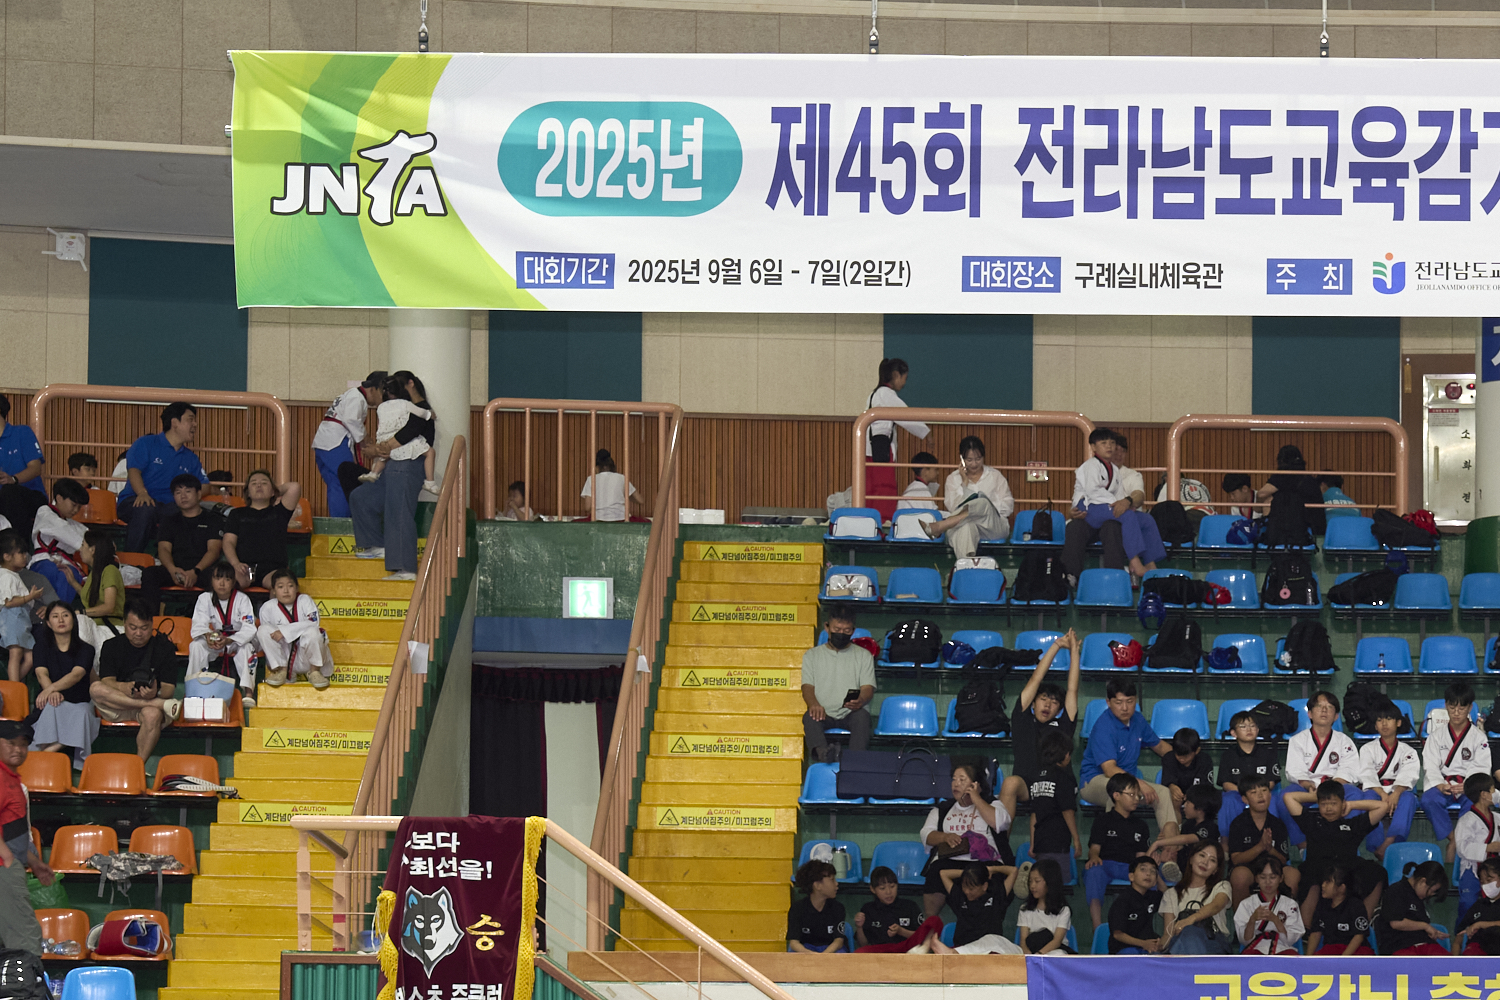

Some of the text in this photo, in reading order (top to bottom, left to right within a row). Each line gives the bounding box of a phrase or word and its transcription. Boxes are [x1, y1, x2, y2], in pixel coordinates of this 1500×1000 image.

[536, 117, 704, 202] 2025년
[765, 101, 982, 217] 제45회
[270, 129, 448, 226] JNTA
[522, 256, 609, 286] 대회기간
[628, 258, 700, 285] 2025년
[708, 258, 742, 286] 9월
[749, 259, 783, 286] 6일
[808, 259, 911, 287] 7일(2일간)
[969, 260, 1224, 290] 대회장소 구례실내체육관
[405, 832, 461, 853] 보다
[409, 857, 492, 880] 최선을!
[466, 913, 505, 951] 승
